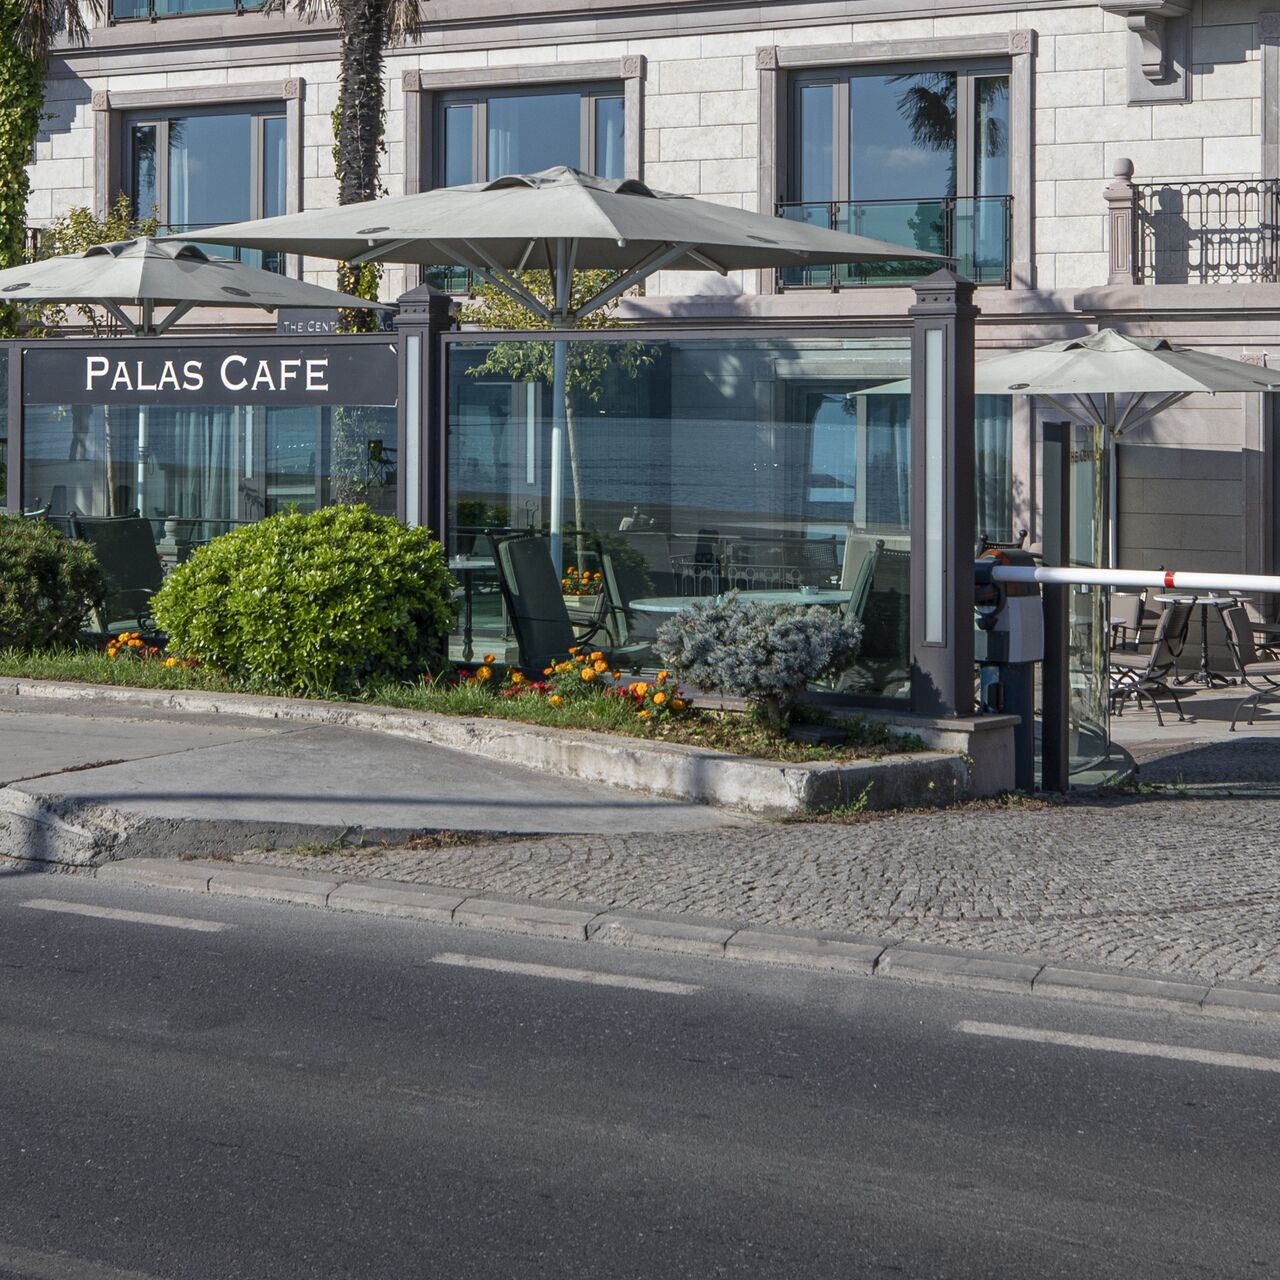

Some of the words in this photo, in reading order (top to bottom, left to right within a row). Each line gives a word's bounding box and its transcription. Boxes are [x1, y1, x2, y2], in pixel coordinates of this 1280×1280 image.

[283, 321, 304, 332] THE
[85, 356, 204, 392] PALAS
[220, 354, 329, 392] CAFE
